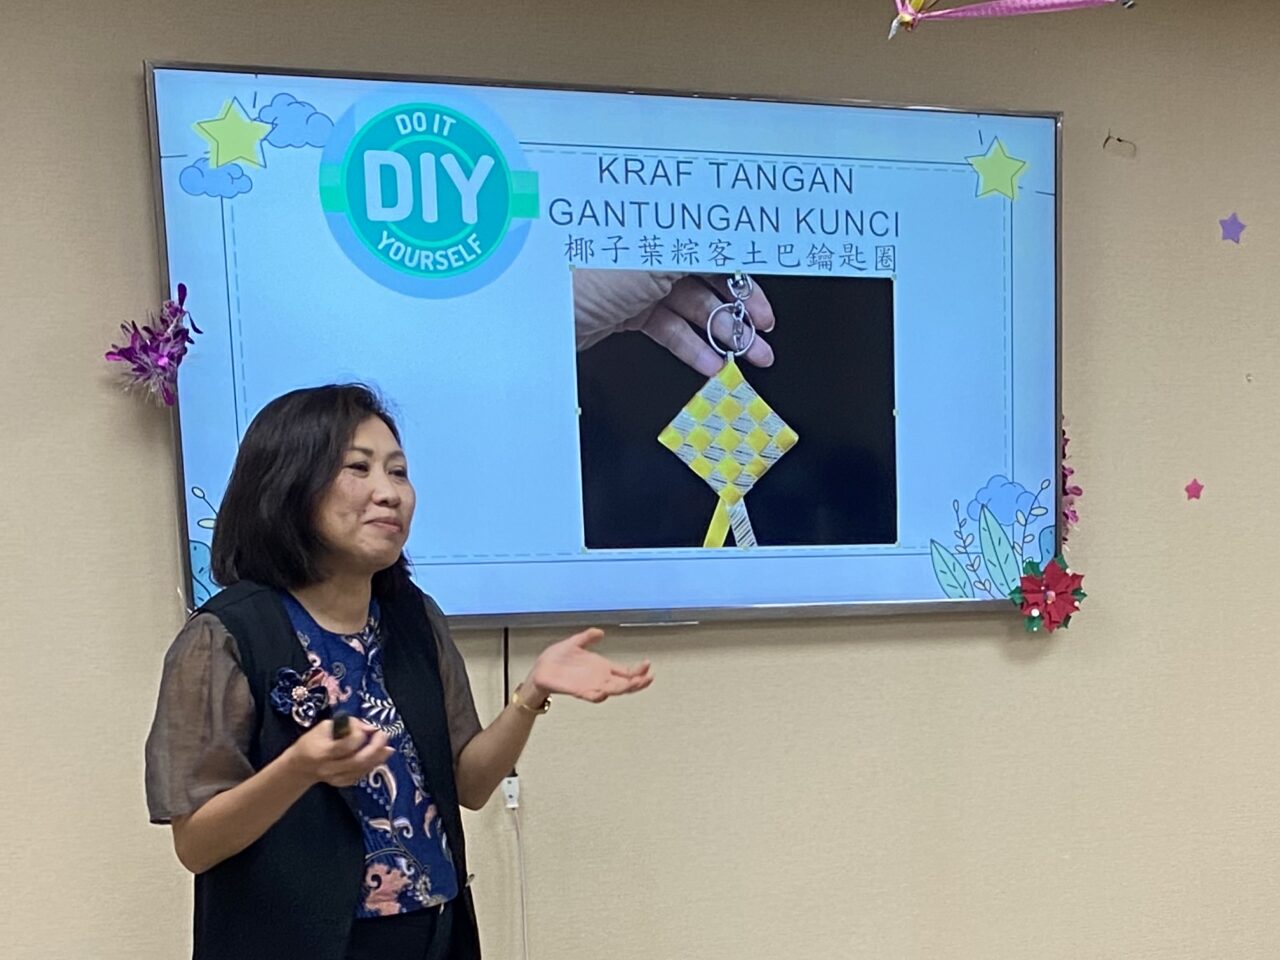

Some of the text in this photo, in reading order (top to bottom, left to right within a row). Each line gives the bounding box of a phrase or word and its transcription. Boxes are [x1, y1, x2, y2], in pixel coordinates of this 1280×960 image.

[395, 111, 456, 136] DO IT
[363, 149, 495, 225] DIY
[598, 156, 853, 194] KRAF TANGAN
[549, 198, 899, 238] GANTUNGAN KUNCI
[377, 230, 482, 271] YOURSELF
[564, 234, 897, 273] 椰子葉粽客土巴鑰匙圈
